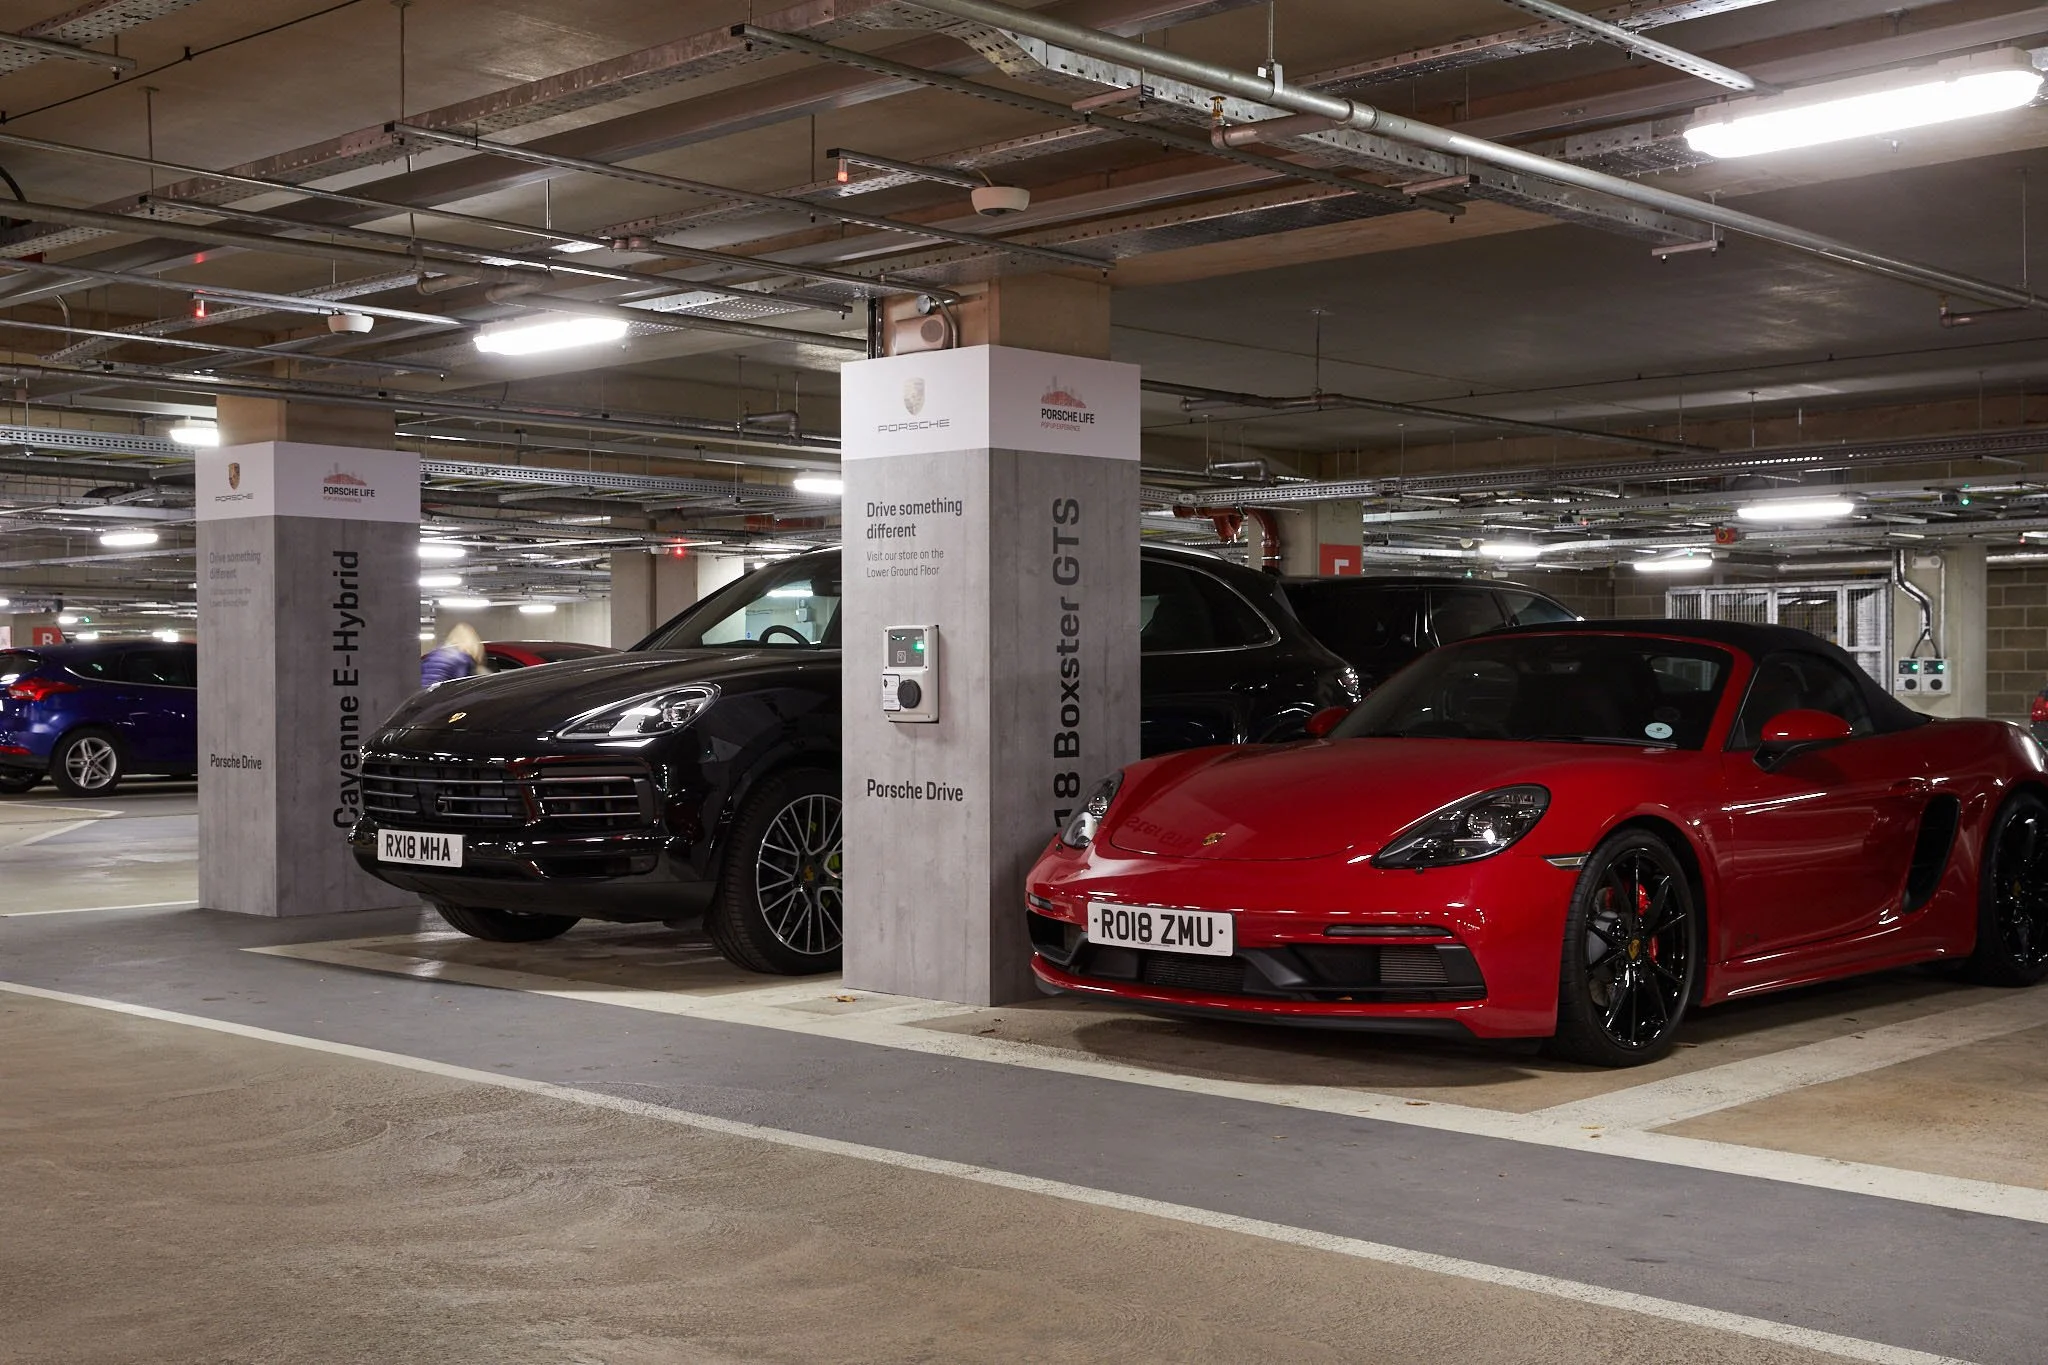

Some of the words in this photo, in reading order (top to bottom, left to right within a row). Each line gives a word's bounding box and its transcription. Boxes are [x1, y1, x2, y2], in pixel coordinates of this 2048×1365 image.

[878, 419, 950, 432] PORSCHE
[1041, 408, 1078, 422] PORSCHE
[1079, 412, 1095, 424] LIFE
[215, 493, 254, 502] PORSCHE
[323, 486, 359, 497] PORSCHE
[359, 489, 376, 498] LIFE
[867, 501, 897, 518] Drive
[899, 497, 963, 517] something
[866, 523, 917, 540] different
[1052, 498, 1080, 586] GTS
[866, 551, 883, 561] Visit
[884, 552, 897, 561] our
[898, 549, 918, 561] store
[920, 551, 930, 560] on
[931, 548, 944, 559] the
[866, 567, 889, 578] Lower
[890, 565, 918, 577] Ground
[920, 564, 940, 576] Floor
[332, 551, 366, 687] E-Hybrid
[1053, 596, 1080, 759] Boxster
[210, 753, 241, 769] Porsche
[241, 755, 262, 770] Drive
[333, 695, 362, 828] Cayenne
[867, 779, 923, 799] Porsche
[926, 781, 963, 801] Drive
[386, 833, 416, 859] RX18
[420, 836, 451, 861] MHA
[1101, 908, 1152, 943] RO18
[1160, 913, 1213, 948] ZMU
